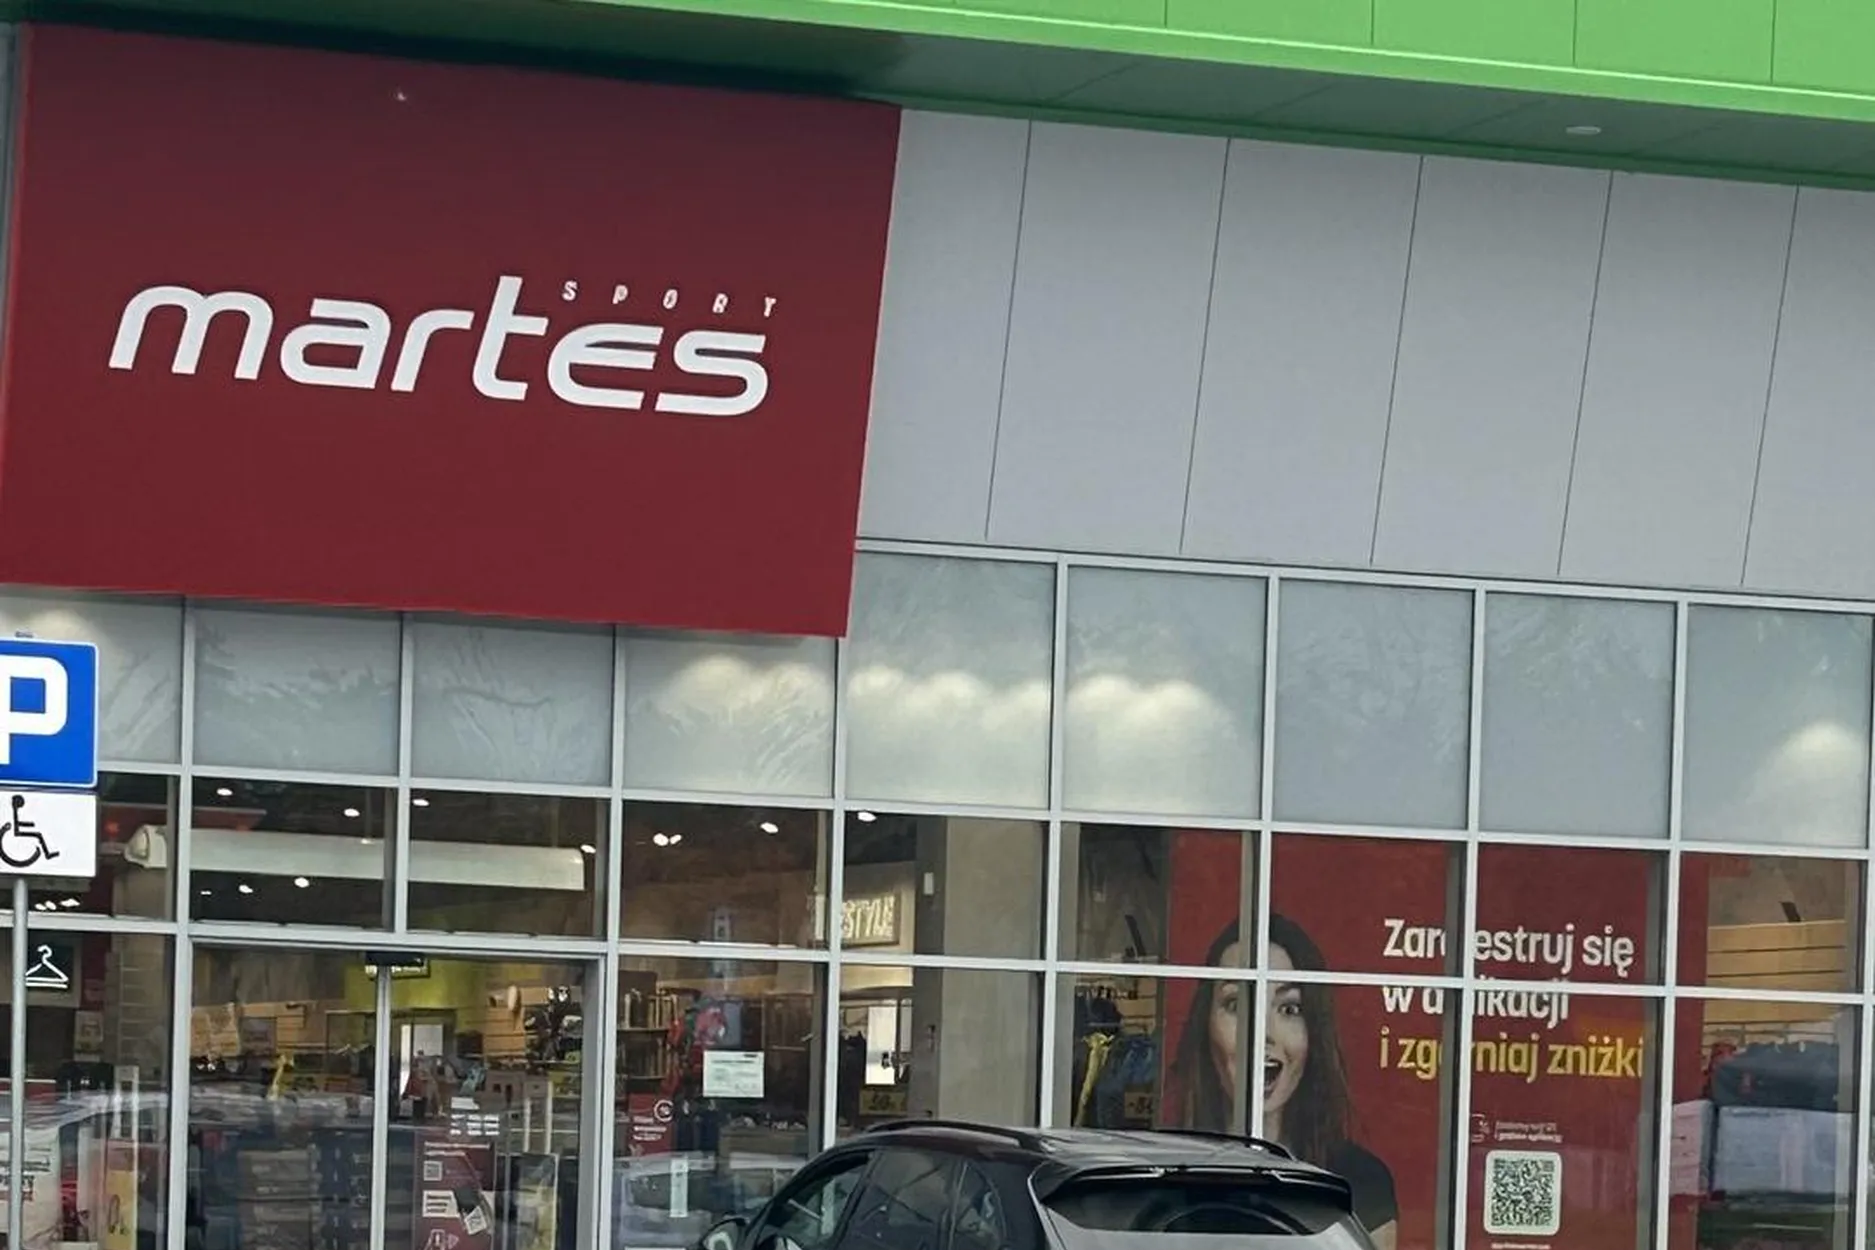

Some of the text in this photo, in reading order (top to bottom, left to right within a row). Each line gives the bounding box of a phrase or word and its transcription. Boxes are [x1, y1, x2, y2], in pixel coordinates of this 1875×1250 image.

[562, 280, 777, 318] SPORT
[108, 274, 769, 417] martes
[0, 654, 69, 766] P
[1383, 918, 1635, 978] Zarestruj się
[1381, 974, 1569, 1029] w aikacji
[1379, 1025, 1390, 1069] i
[1397, 1031, 1540, 1084] zgniaj
